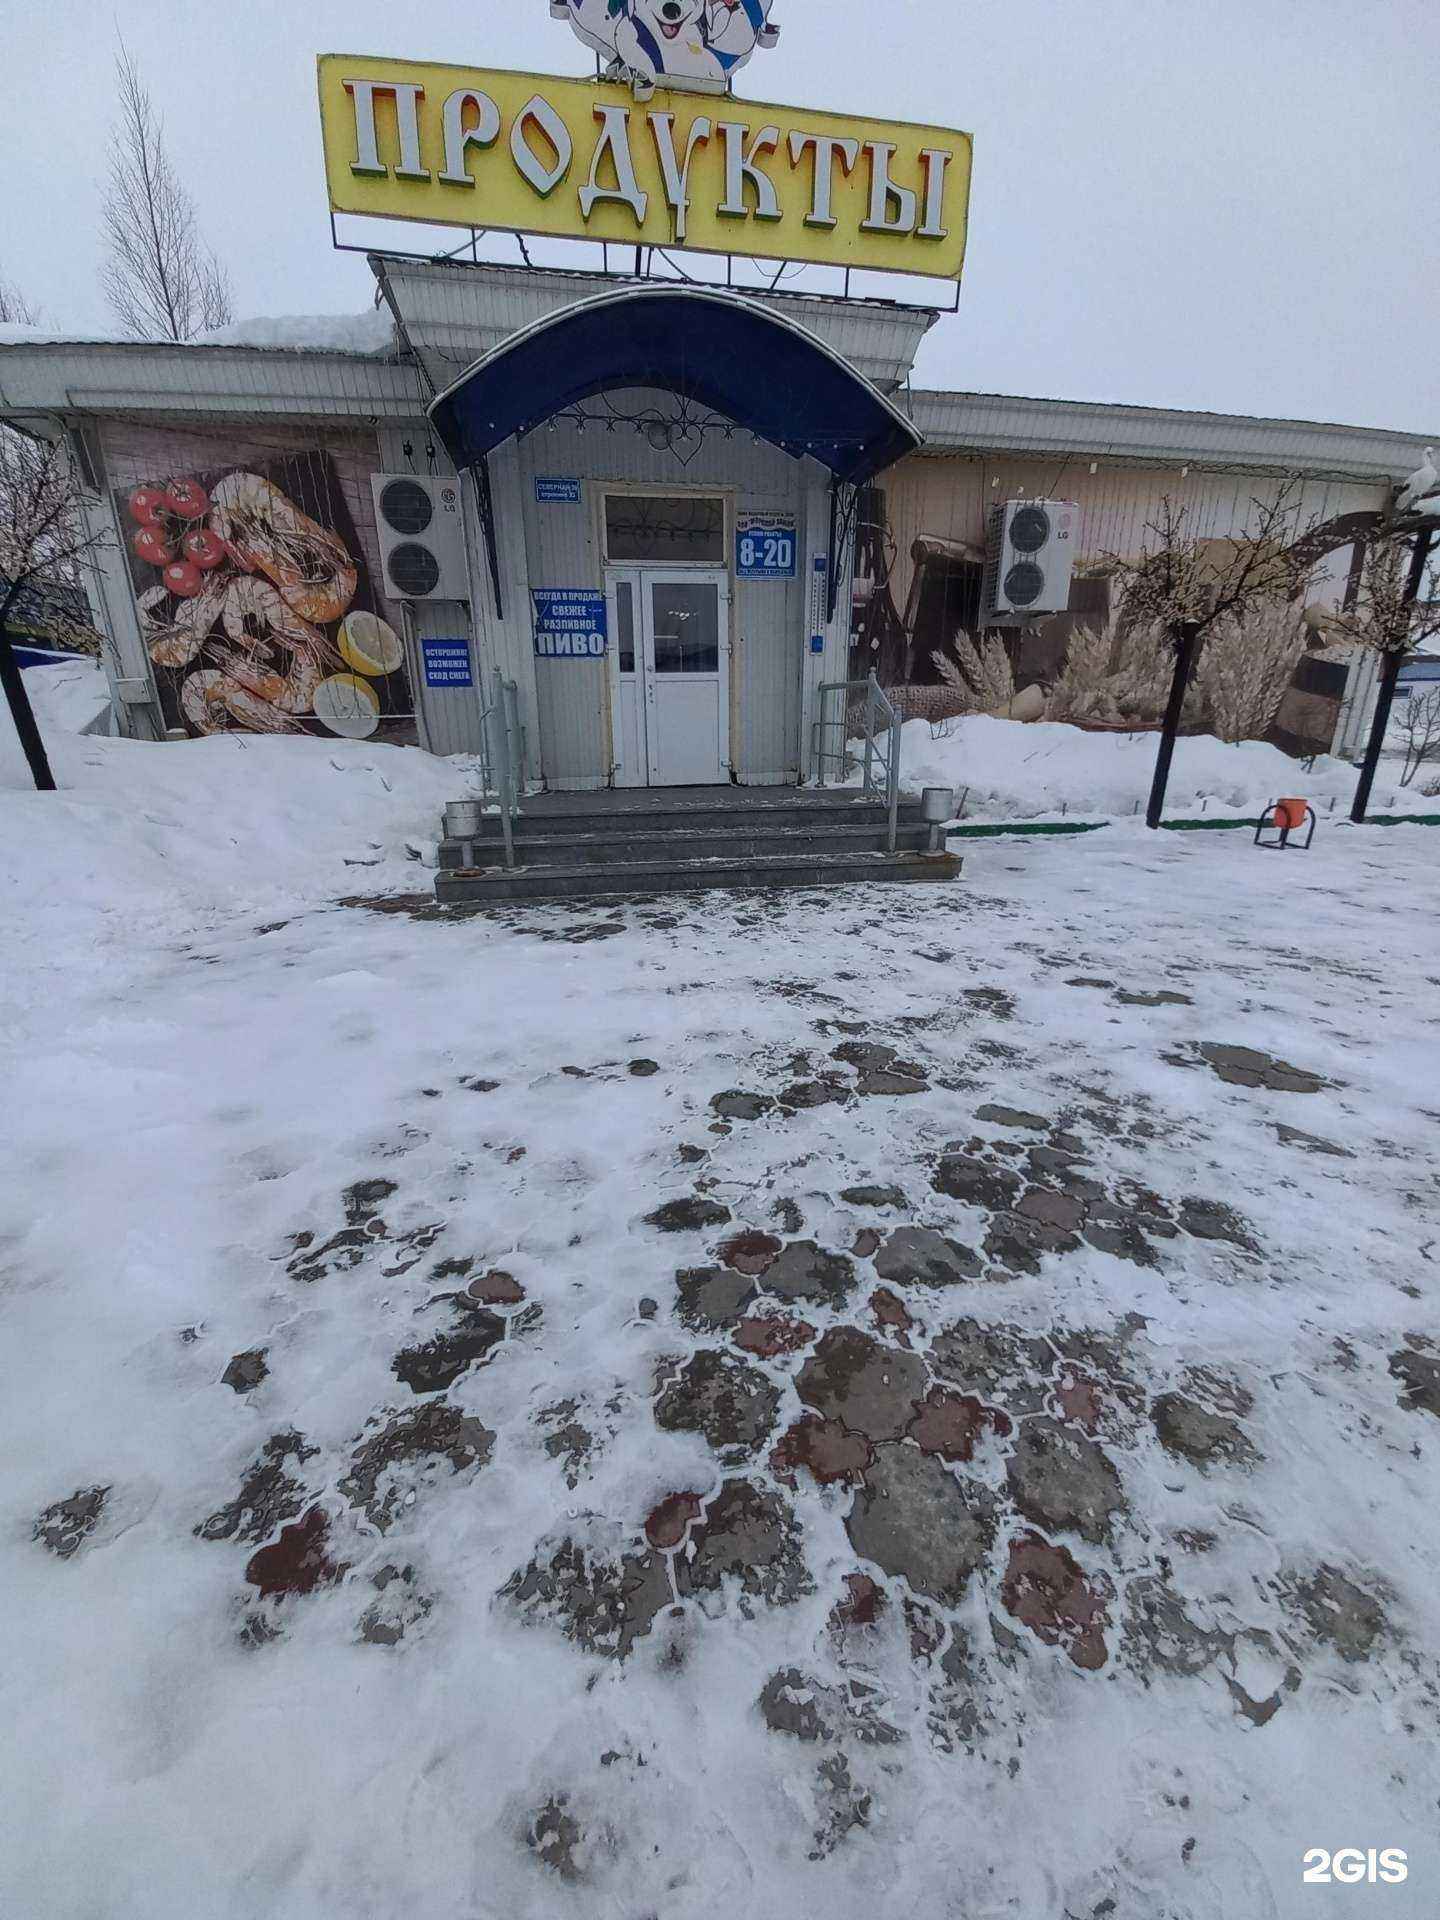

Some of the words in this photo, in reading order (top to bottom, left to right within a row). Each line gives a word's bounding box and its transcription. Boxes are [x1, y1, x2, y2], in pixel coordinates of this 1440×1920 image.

[342, 78, 954, 245] ПРОДУКТЫ
[1057, 531, 1069, 540] LG
[740, 538, 792, 568] 8-20
[552, 605, 588, 616] СВЕЖЕЕ
[537, 632, 604, 655] ПИВО
